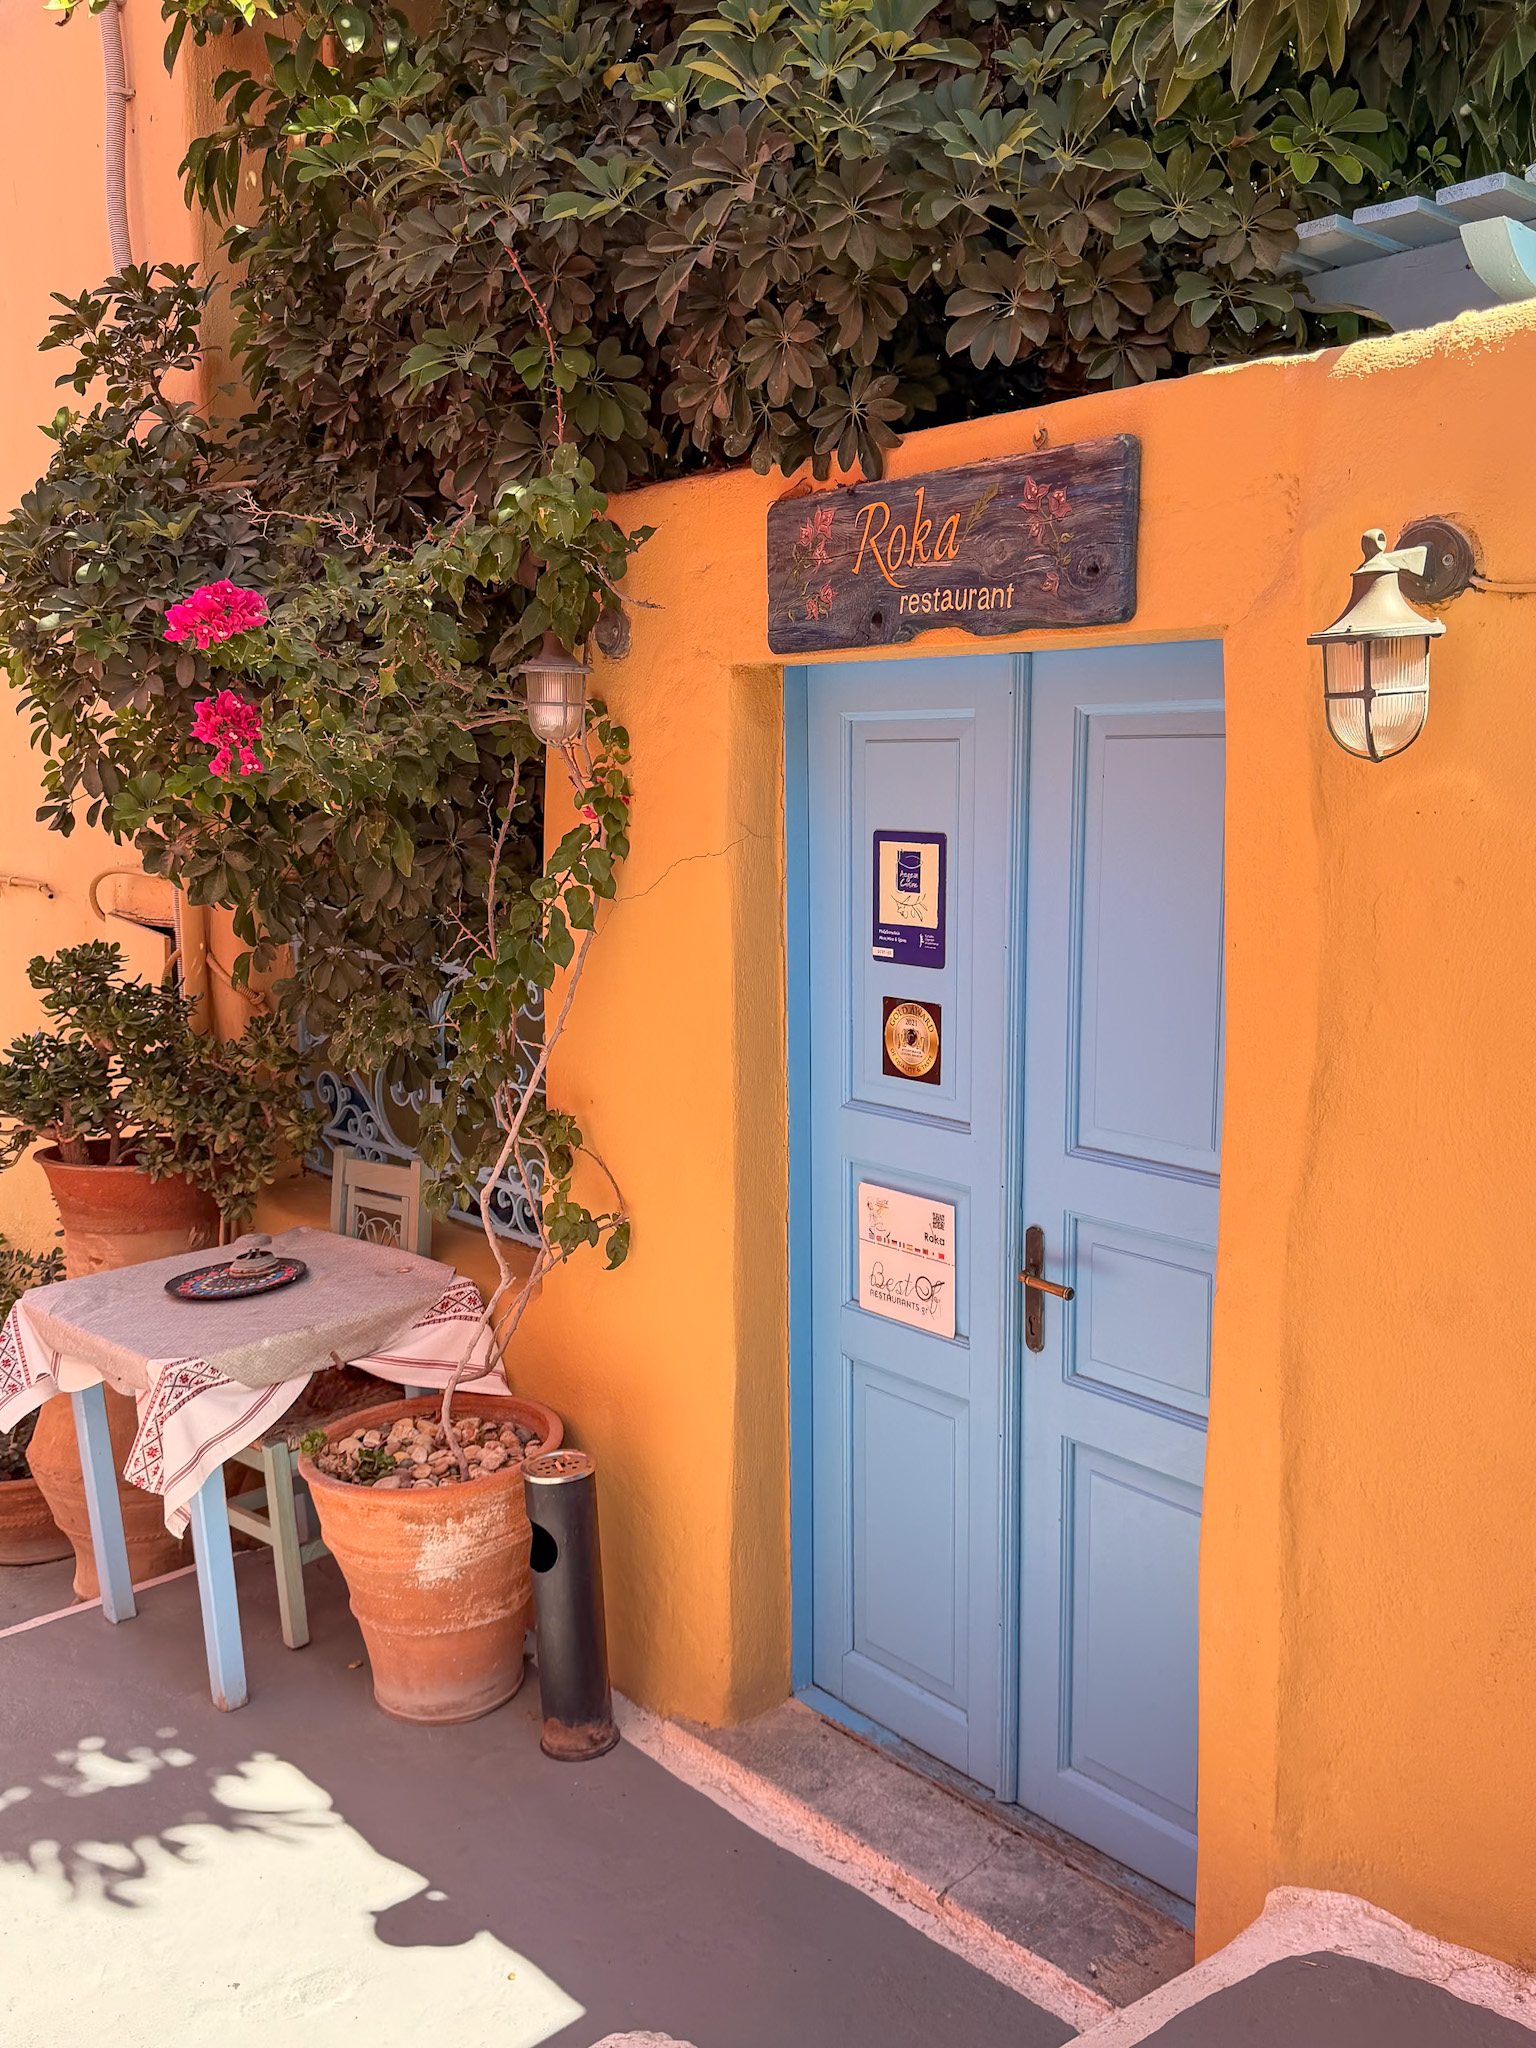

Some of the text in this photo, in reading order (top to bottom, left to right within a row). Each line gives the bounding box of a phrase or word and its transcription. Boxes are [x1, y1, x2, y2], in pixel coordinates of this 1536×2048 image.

[852, 486, 961, 588] Roka
[899, 583, 1015, 615] restaurant
[890, 1006, 934, 1033] GOLD AWARD
[924, 1232, 945, 1246] Roka
[869, 1261, 914, 1297] Best
[869, 1289, 929, 1316] RESTAURANTS.gr
